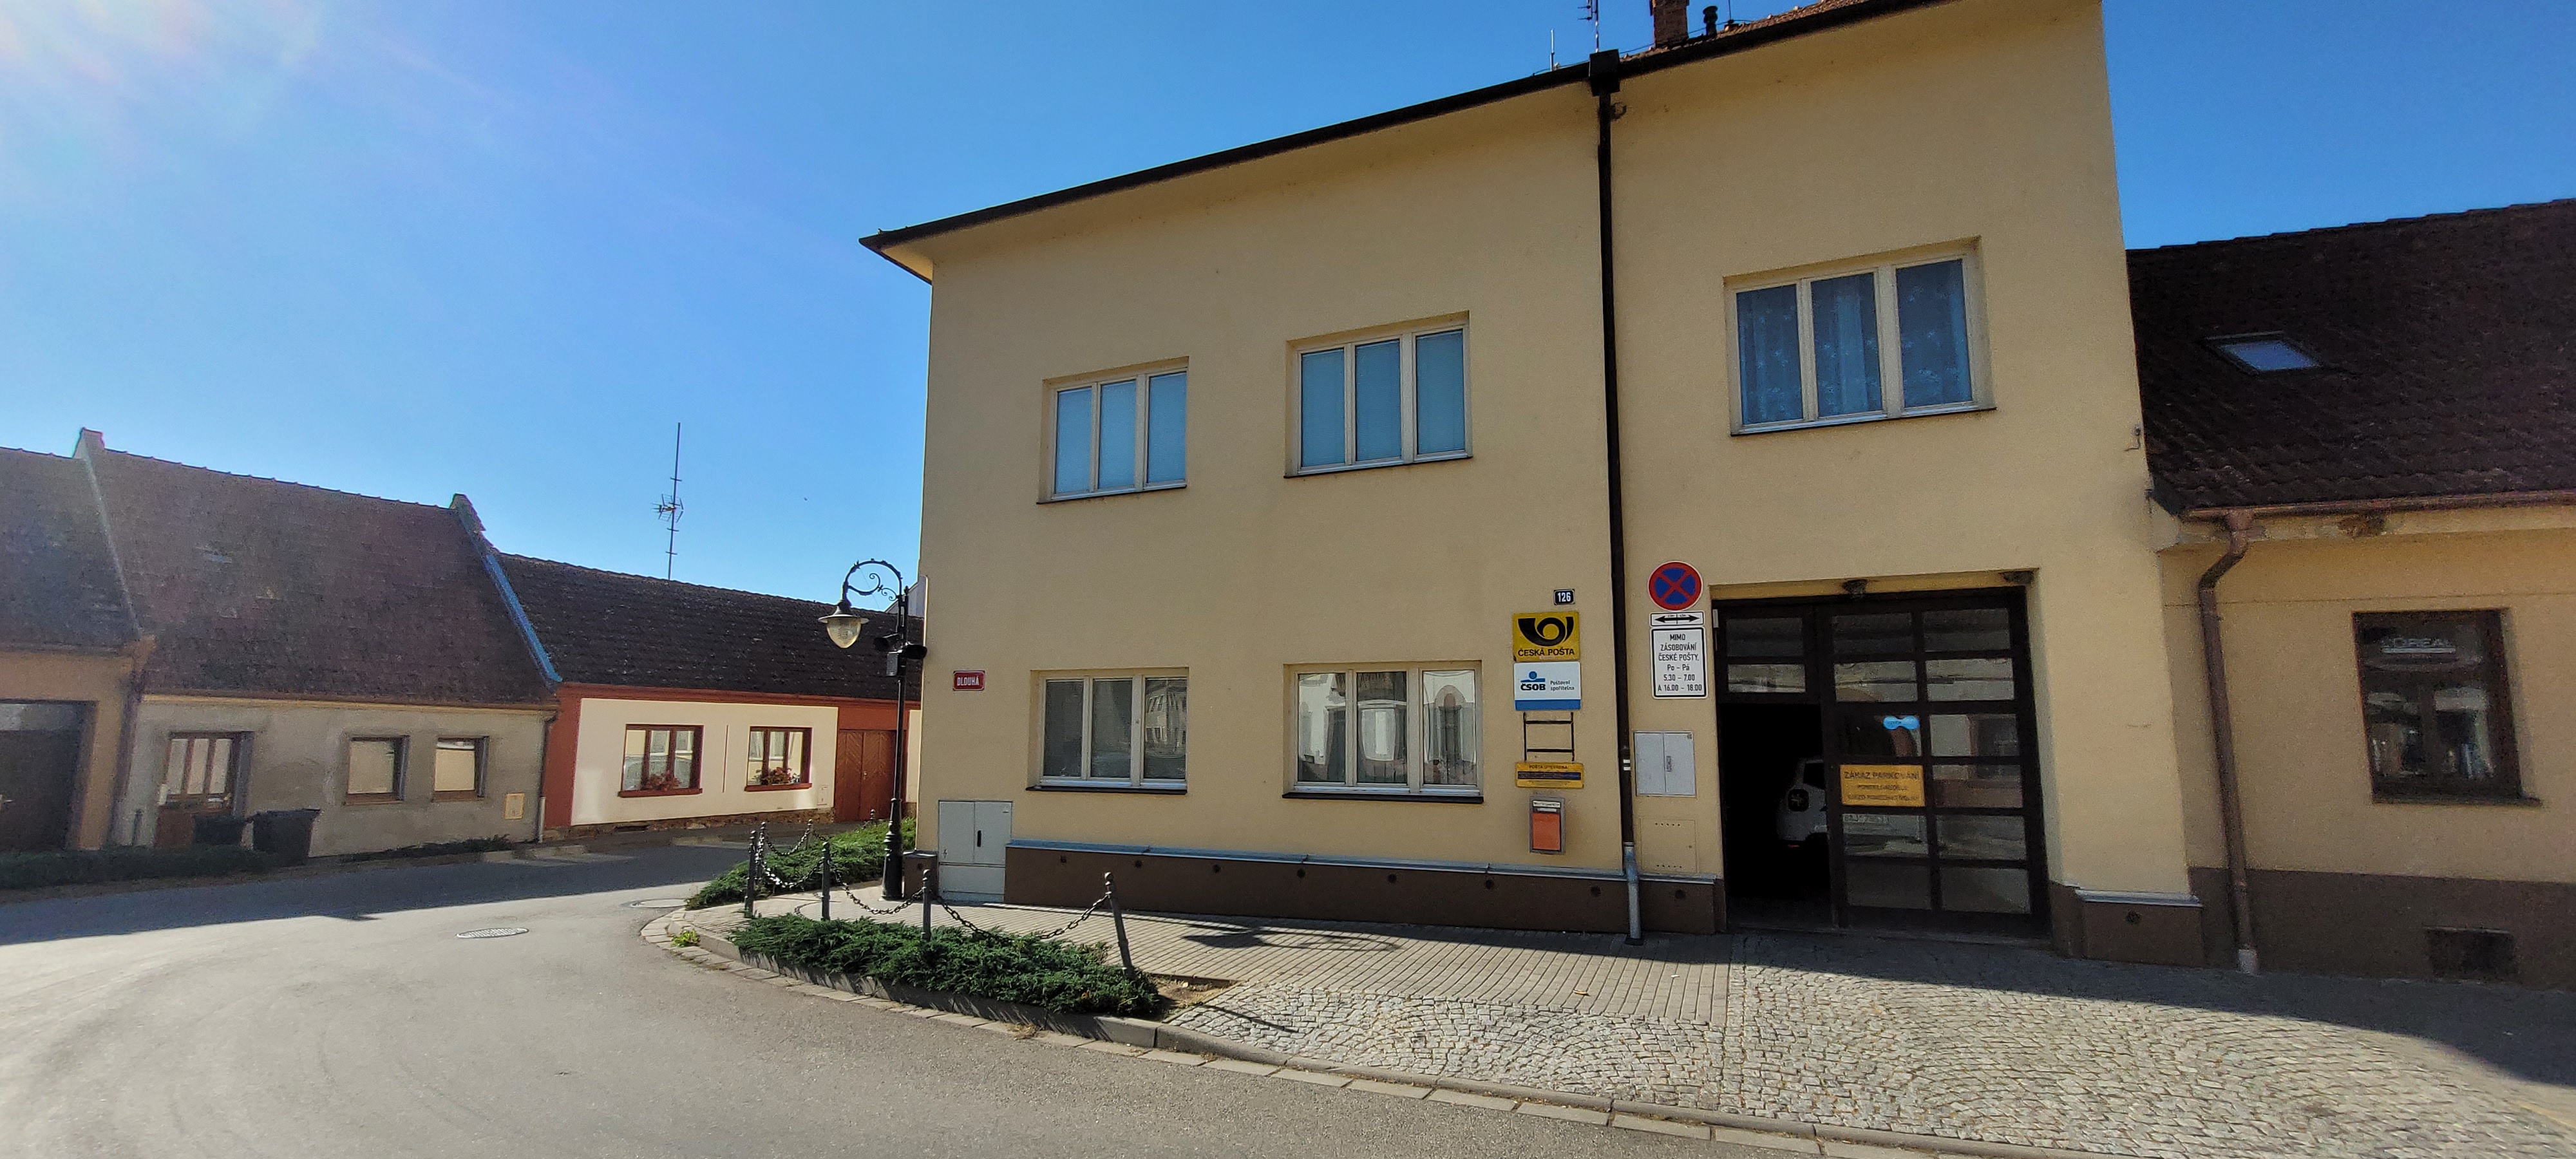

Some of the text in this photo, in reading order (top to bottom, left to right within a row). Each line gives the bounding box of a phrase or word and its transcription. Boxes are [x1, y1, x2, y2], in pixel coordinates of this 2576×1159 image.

[1557, 592, 1571, 602] 126
[1518, 647, 1575, 657] ČESKÁ POŠTA
[1660, 643, 1697, 652] ZÁSOBOVÁNÍ
[1658, 653, 1677, 661] ČESKÉ
[957, 675, 980, 686] DLOUHÁ
